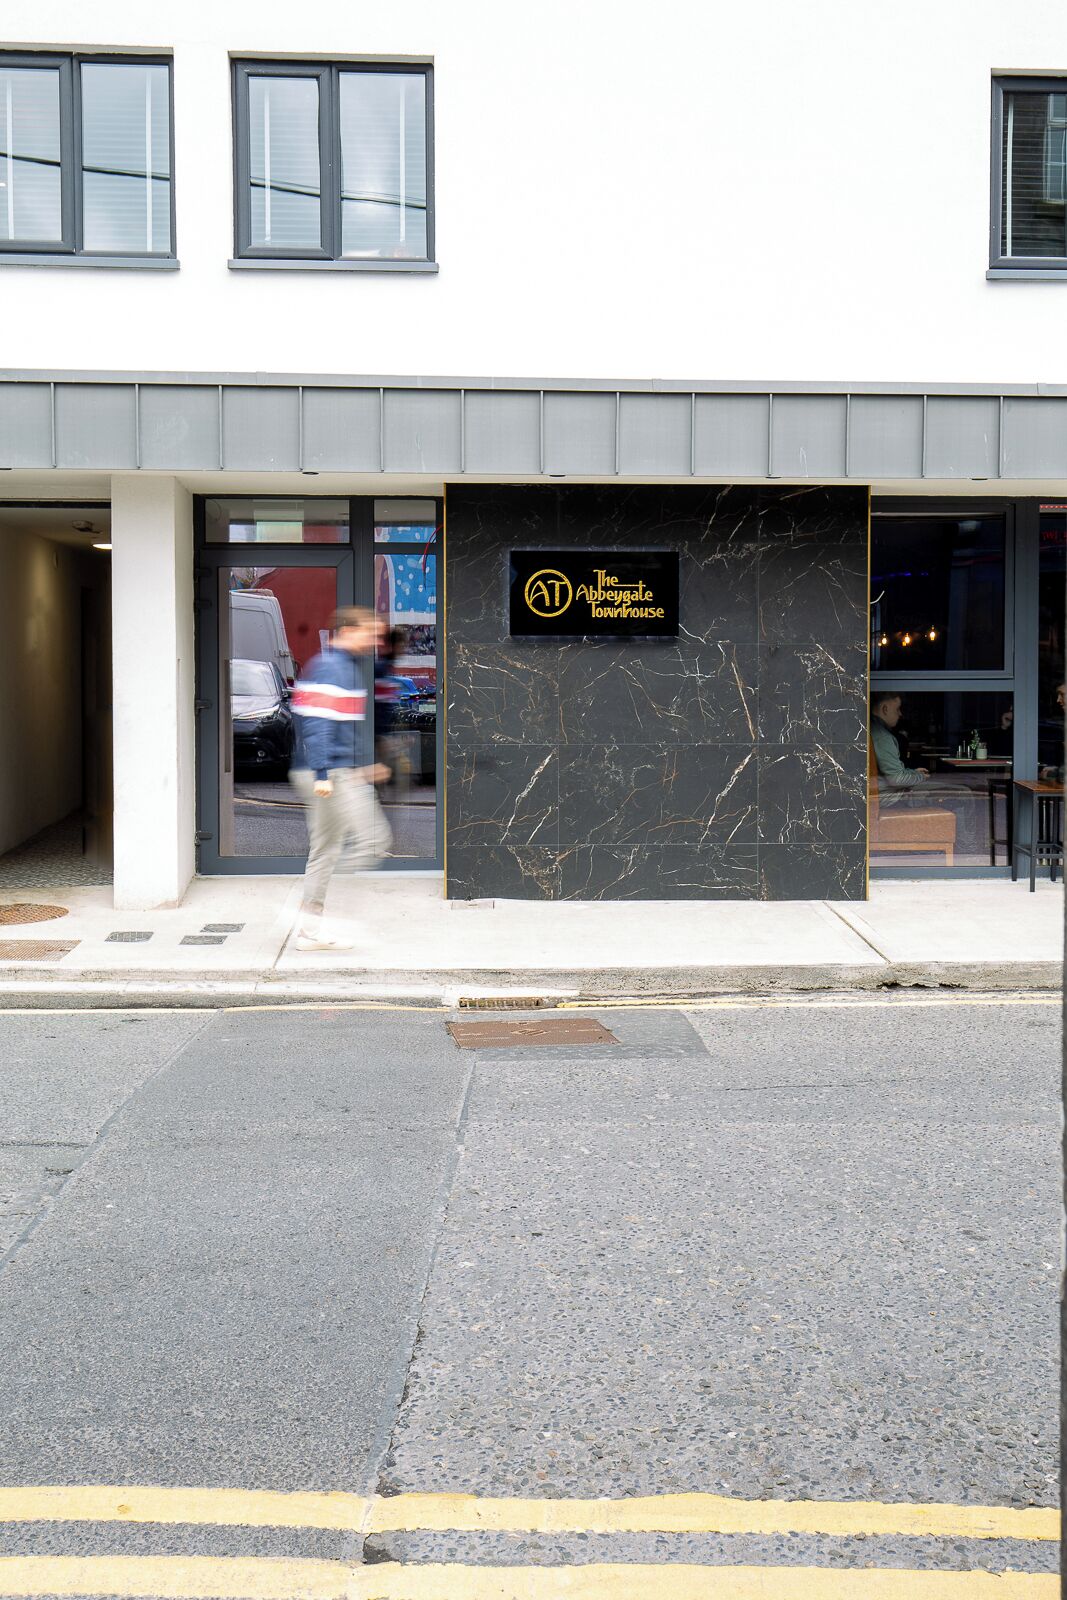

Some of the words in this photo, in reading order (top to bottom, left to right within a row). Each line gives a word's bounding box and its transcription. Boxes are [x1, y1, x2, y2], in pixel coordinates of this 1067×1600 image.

[593, 569, 619, 587] The
[529, 579, 568, 607] AT
[576, 581, 653, 605] Abbeygate
[587, 600, 665, 618] Townhouse
